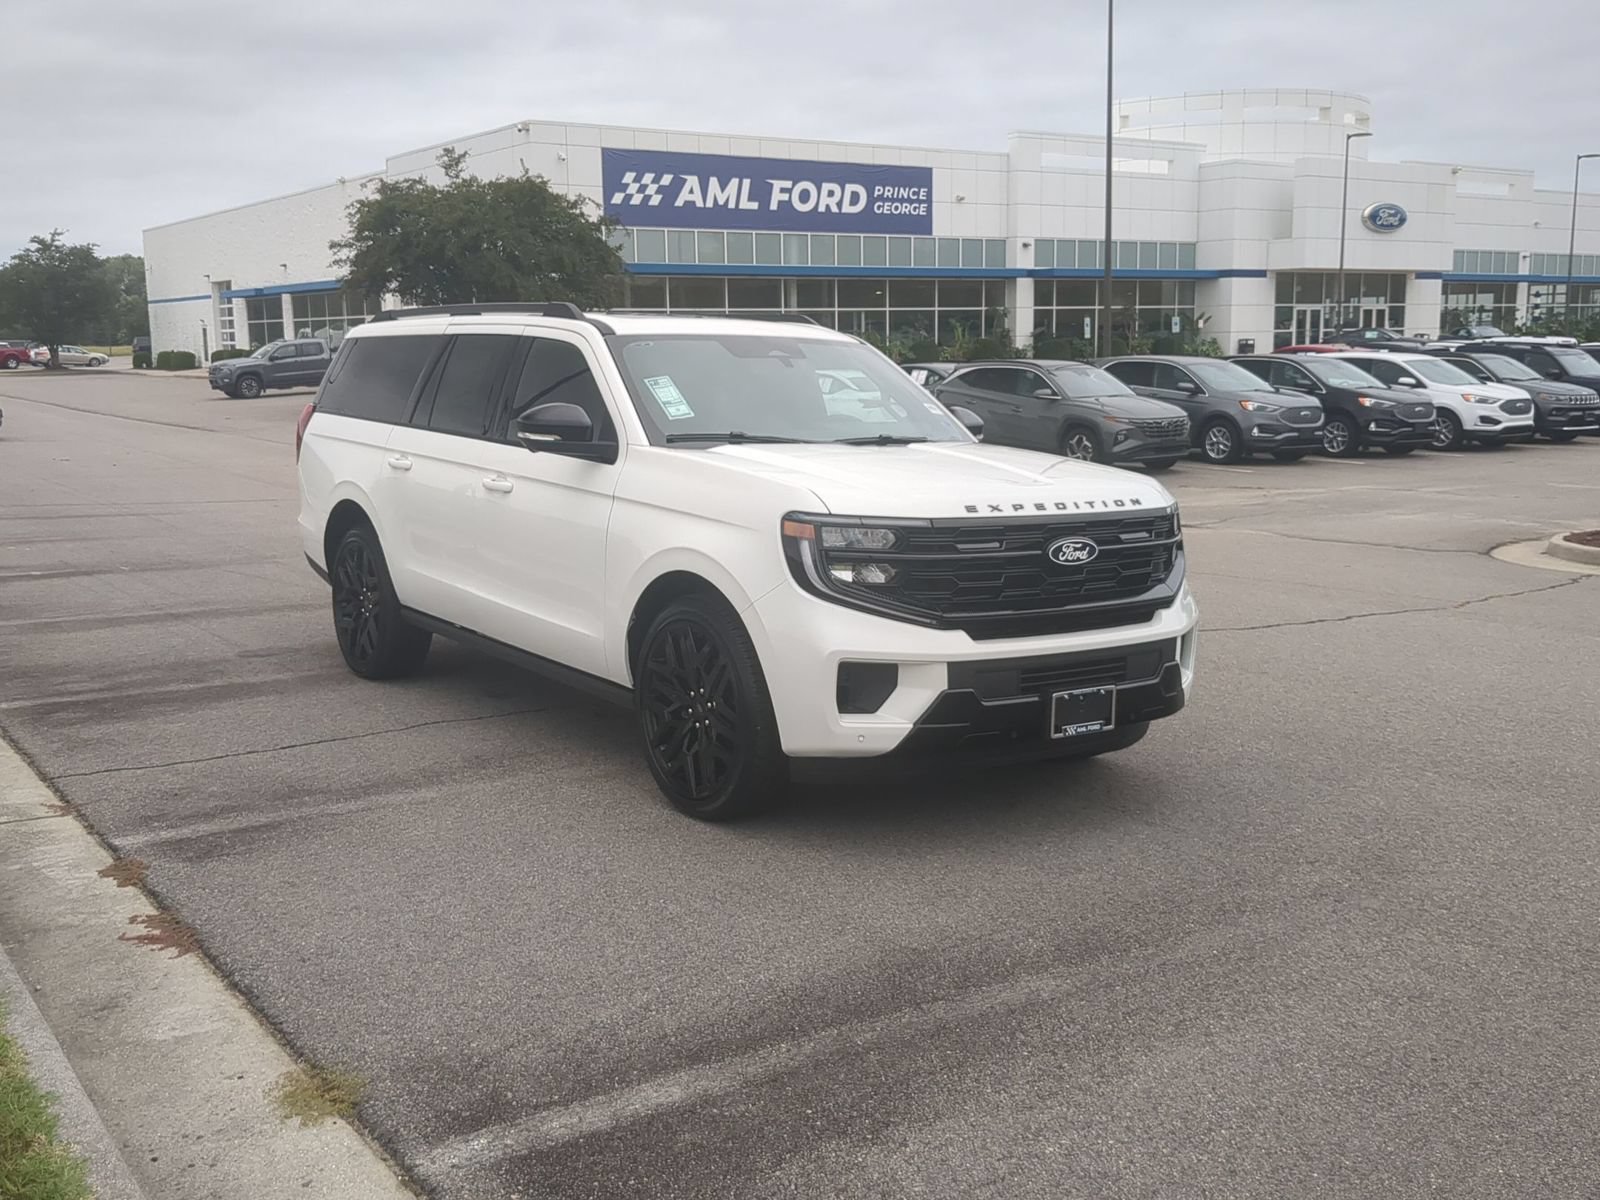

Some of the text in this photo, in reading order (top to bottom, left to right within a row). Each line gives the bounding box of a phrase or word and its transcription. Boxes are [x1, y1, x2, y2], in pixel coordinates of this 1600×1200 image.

[674, 175, 867, 213] AML FORD
[873, 186, 928, 200] PRINCE
[873, 202, 928, 216] GEORGE
[1376, 208, 1401, 226] Ford
[964, 498, 1143, 514] EXPEDITION
[1058, 543, 1090, 561] Ford
